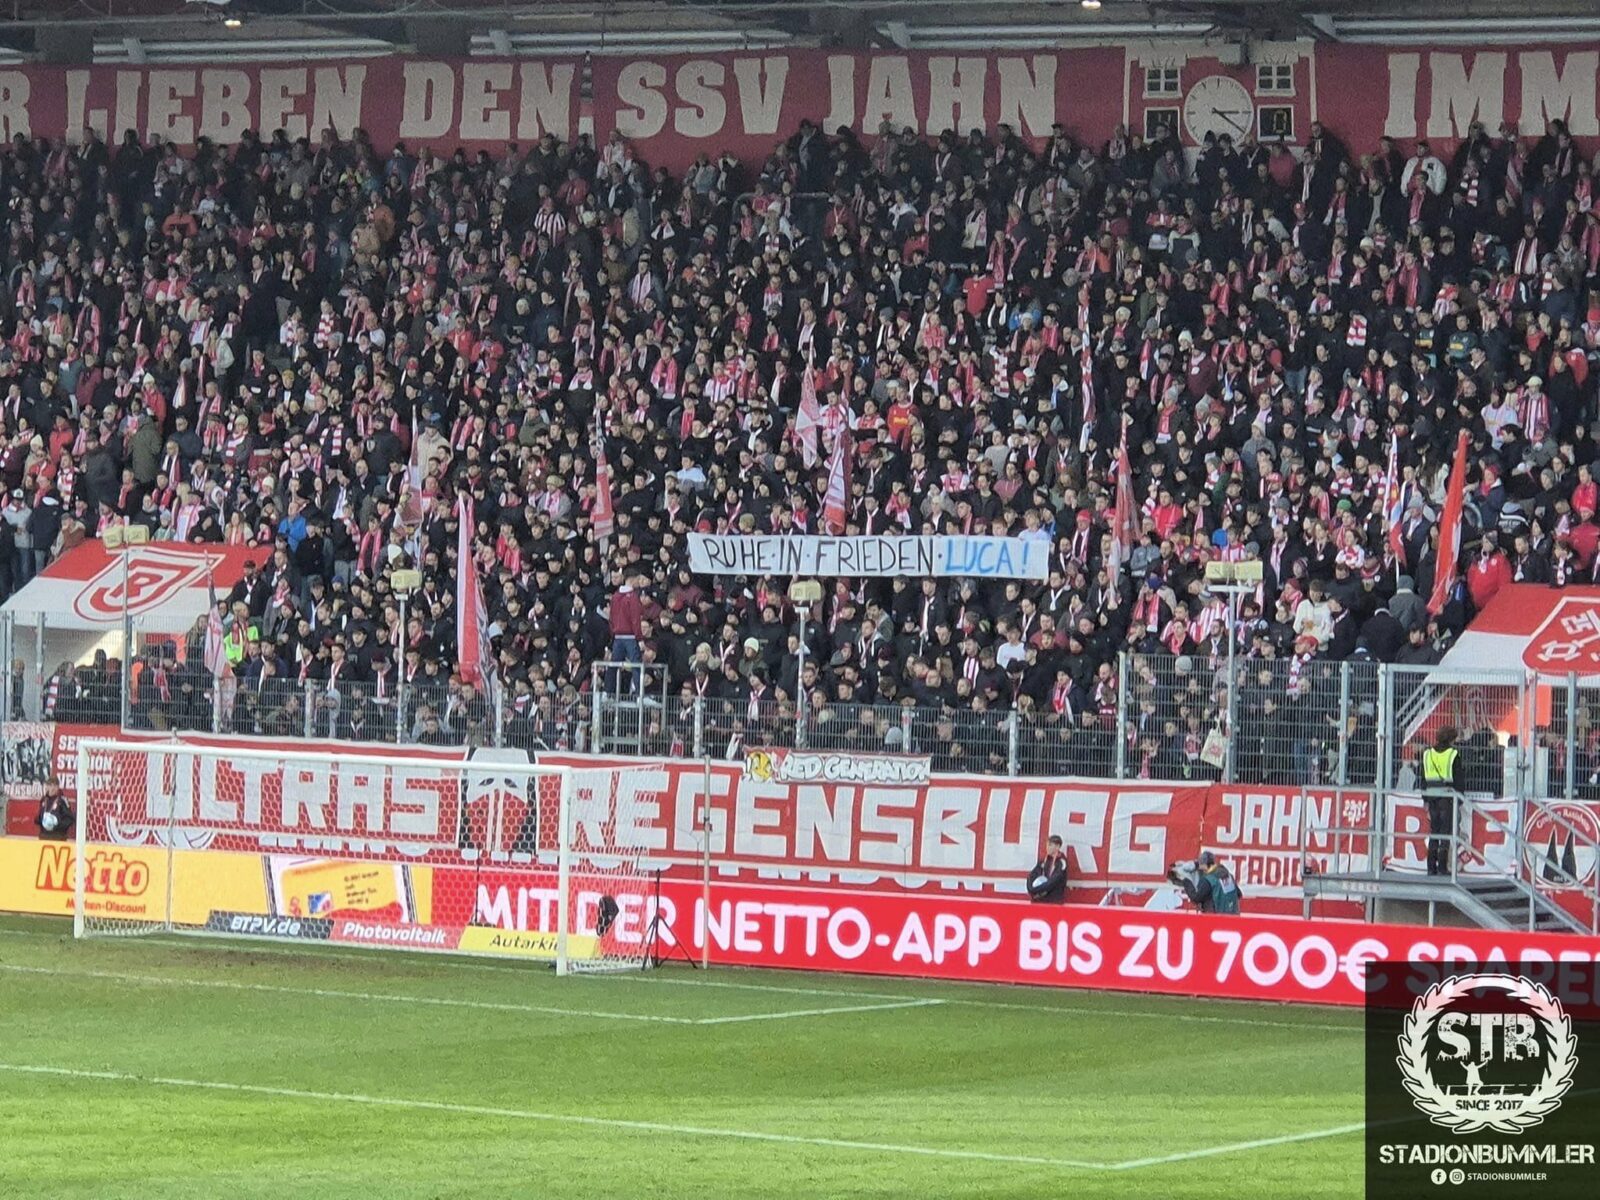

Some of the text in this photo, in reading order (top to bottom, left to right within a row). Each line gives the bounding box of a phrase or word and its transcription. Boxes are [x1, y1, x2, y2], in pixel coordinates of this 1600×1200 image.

[66, 64, 367, 145] LIEBEN
[402, 61, 575, 140] DEN
[616, 56, 790, 138] SSV
[823, 54, 1058, 138] JAHN
[703, 538, 1029, 575] RUHE IN FRIEDEN LUCA!
[146, 752, 440, 835] ULTRAS
[570, 770, 1172, 875] REGENSBURG
[1217, 793, 1331, 847] JAHN
[36, 845, 149, 896] Netto
[231, 915, 300, 935] BTPV.de
[477, 884, 1600, 1007] MIT DER NETTO-APP BIS ZU 700€ SPARE
